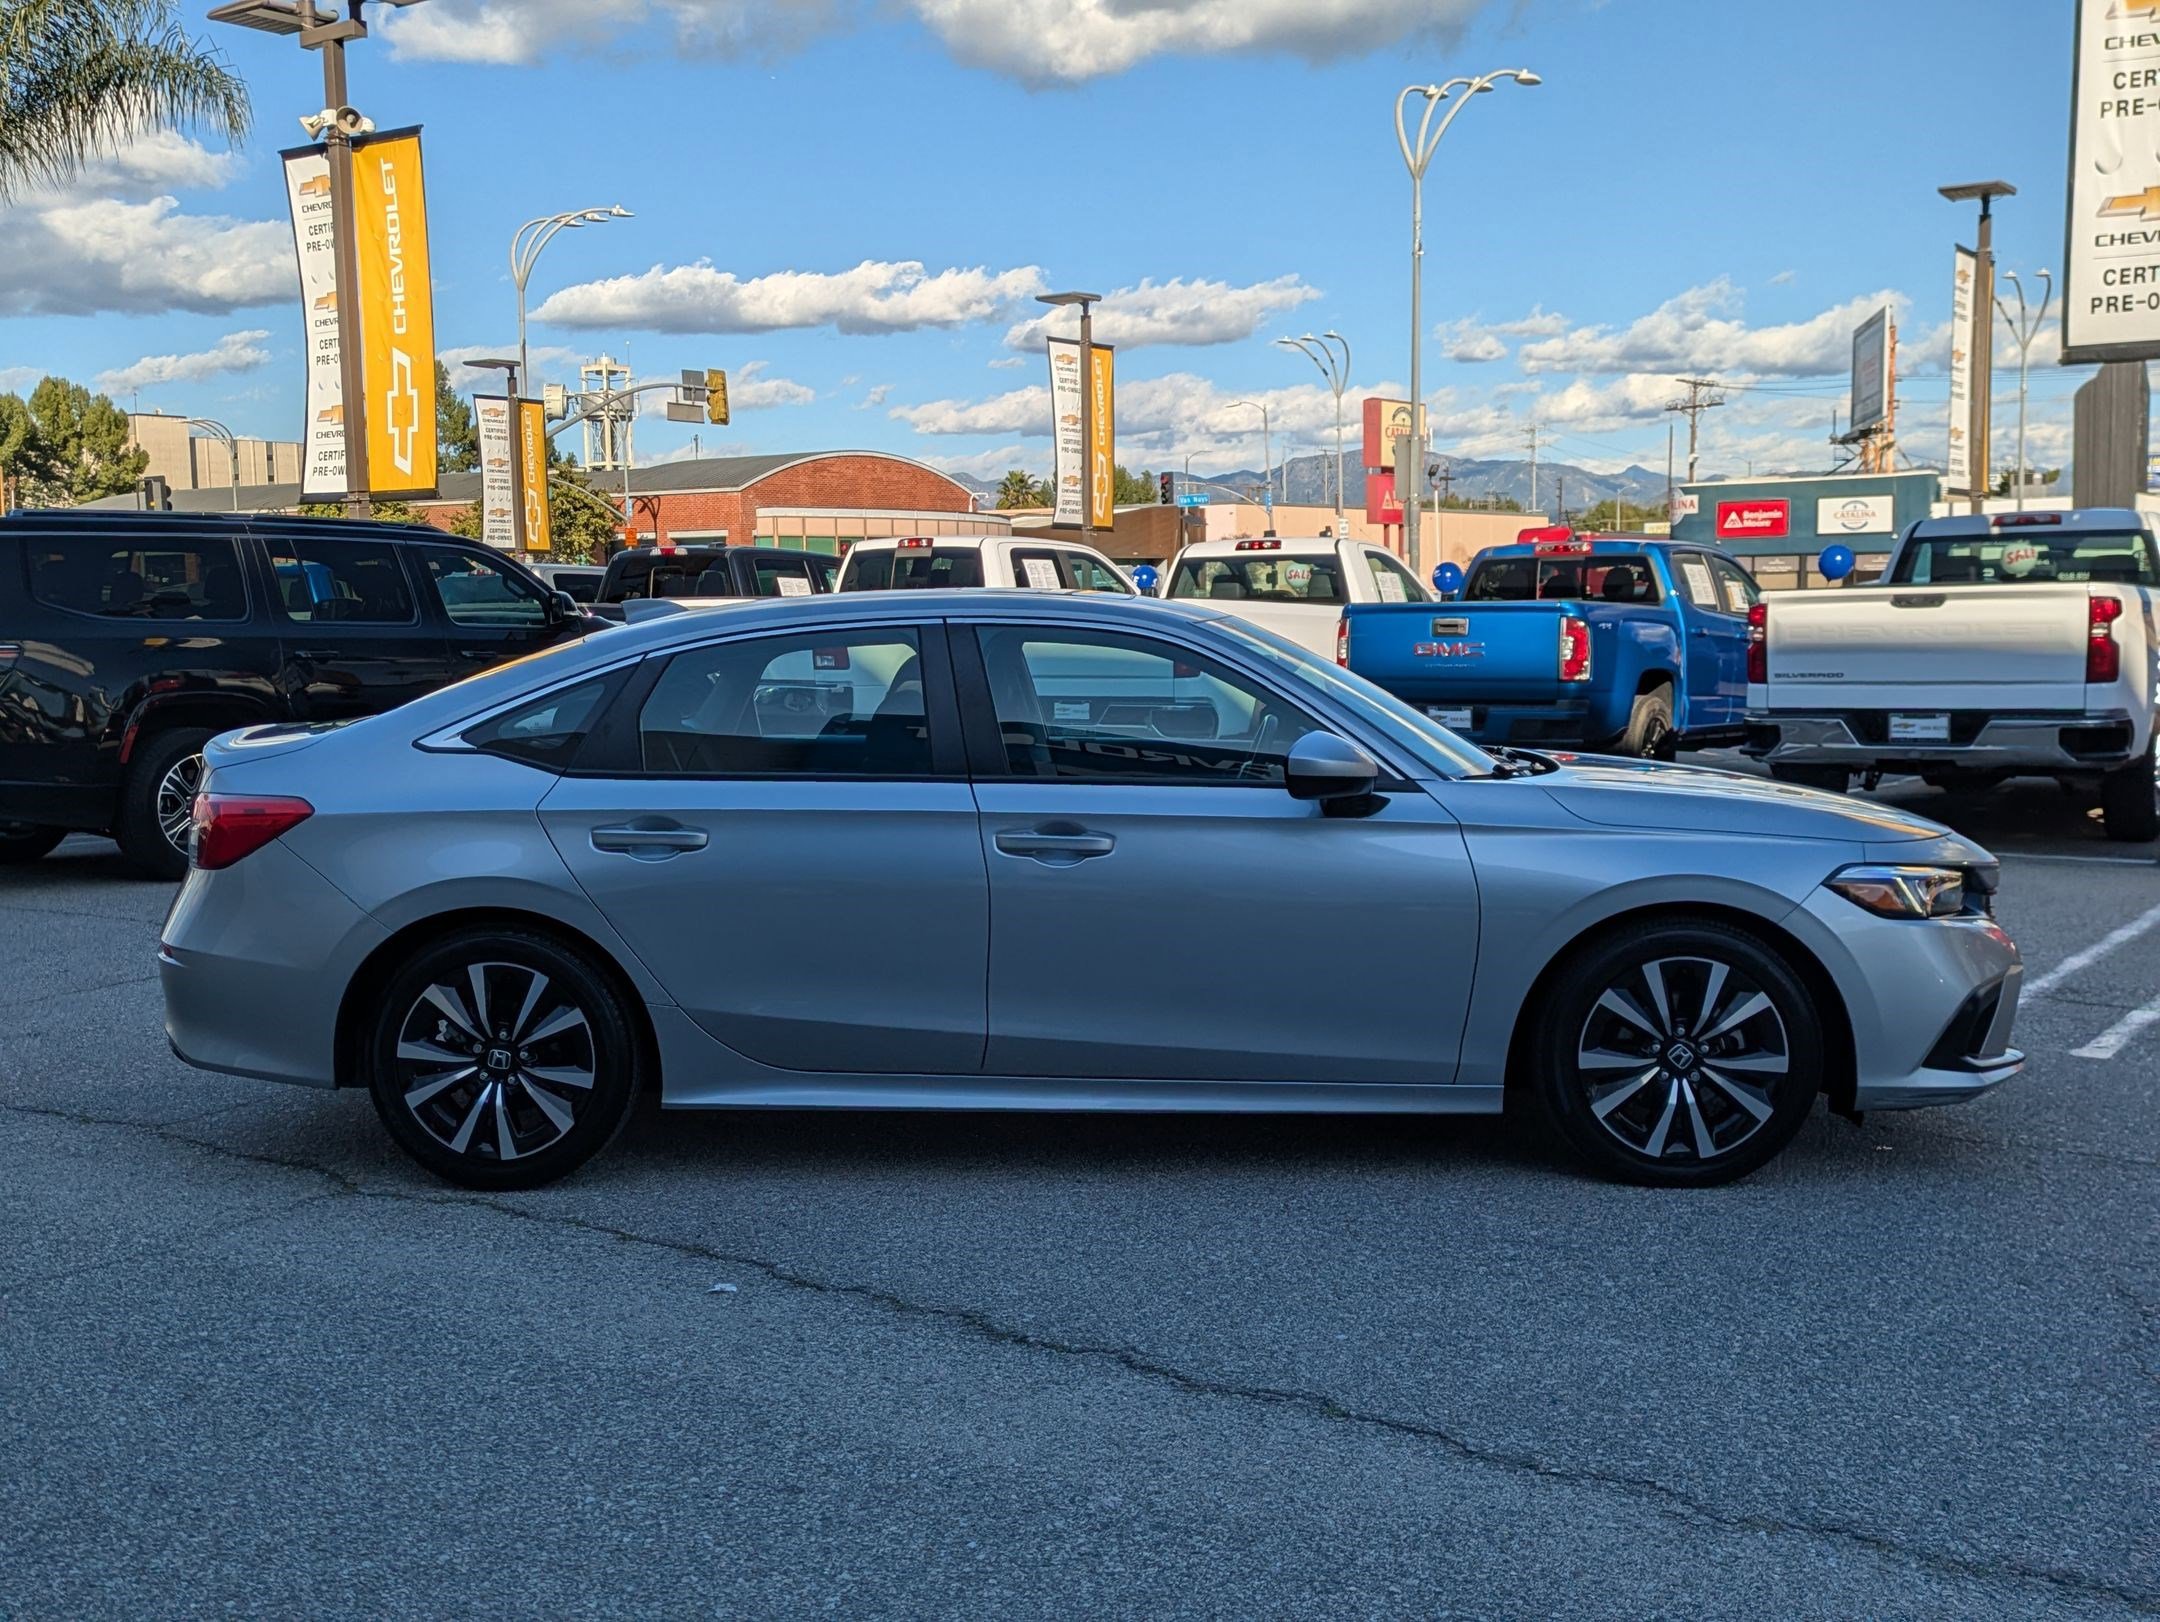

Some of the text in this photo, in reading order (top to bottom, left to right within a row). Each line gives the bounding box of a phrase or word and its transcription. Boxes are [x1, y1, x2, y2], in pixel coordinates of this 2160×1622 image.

[2113, 68, 2160, 90] CER
[2100, 97, 2160, 119] PRE-
[380, 157, 407, 335] CHEVROLET
[2094, 230, 2160, 247] CHEV
[316, 353, 341, 366] PRE-O
[525, 411, 535, 483] CHEVROLET
[312, 465, 347, 477] PRE-OW
[1742, 509, 1783, 520] Benjamin
[1833, 511, 1877, 519] CATALINA
[1743, 519, 1773, 528] Moore
[1789, 623, 2065, 641] CHEVROLET
[1413, 641, 1486, 657] GMC
